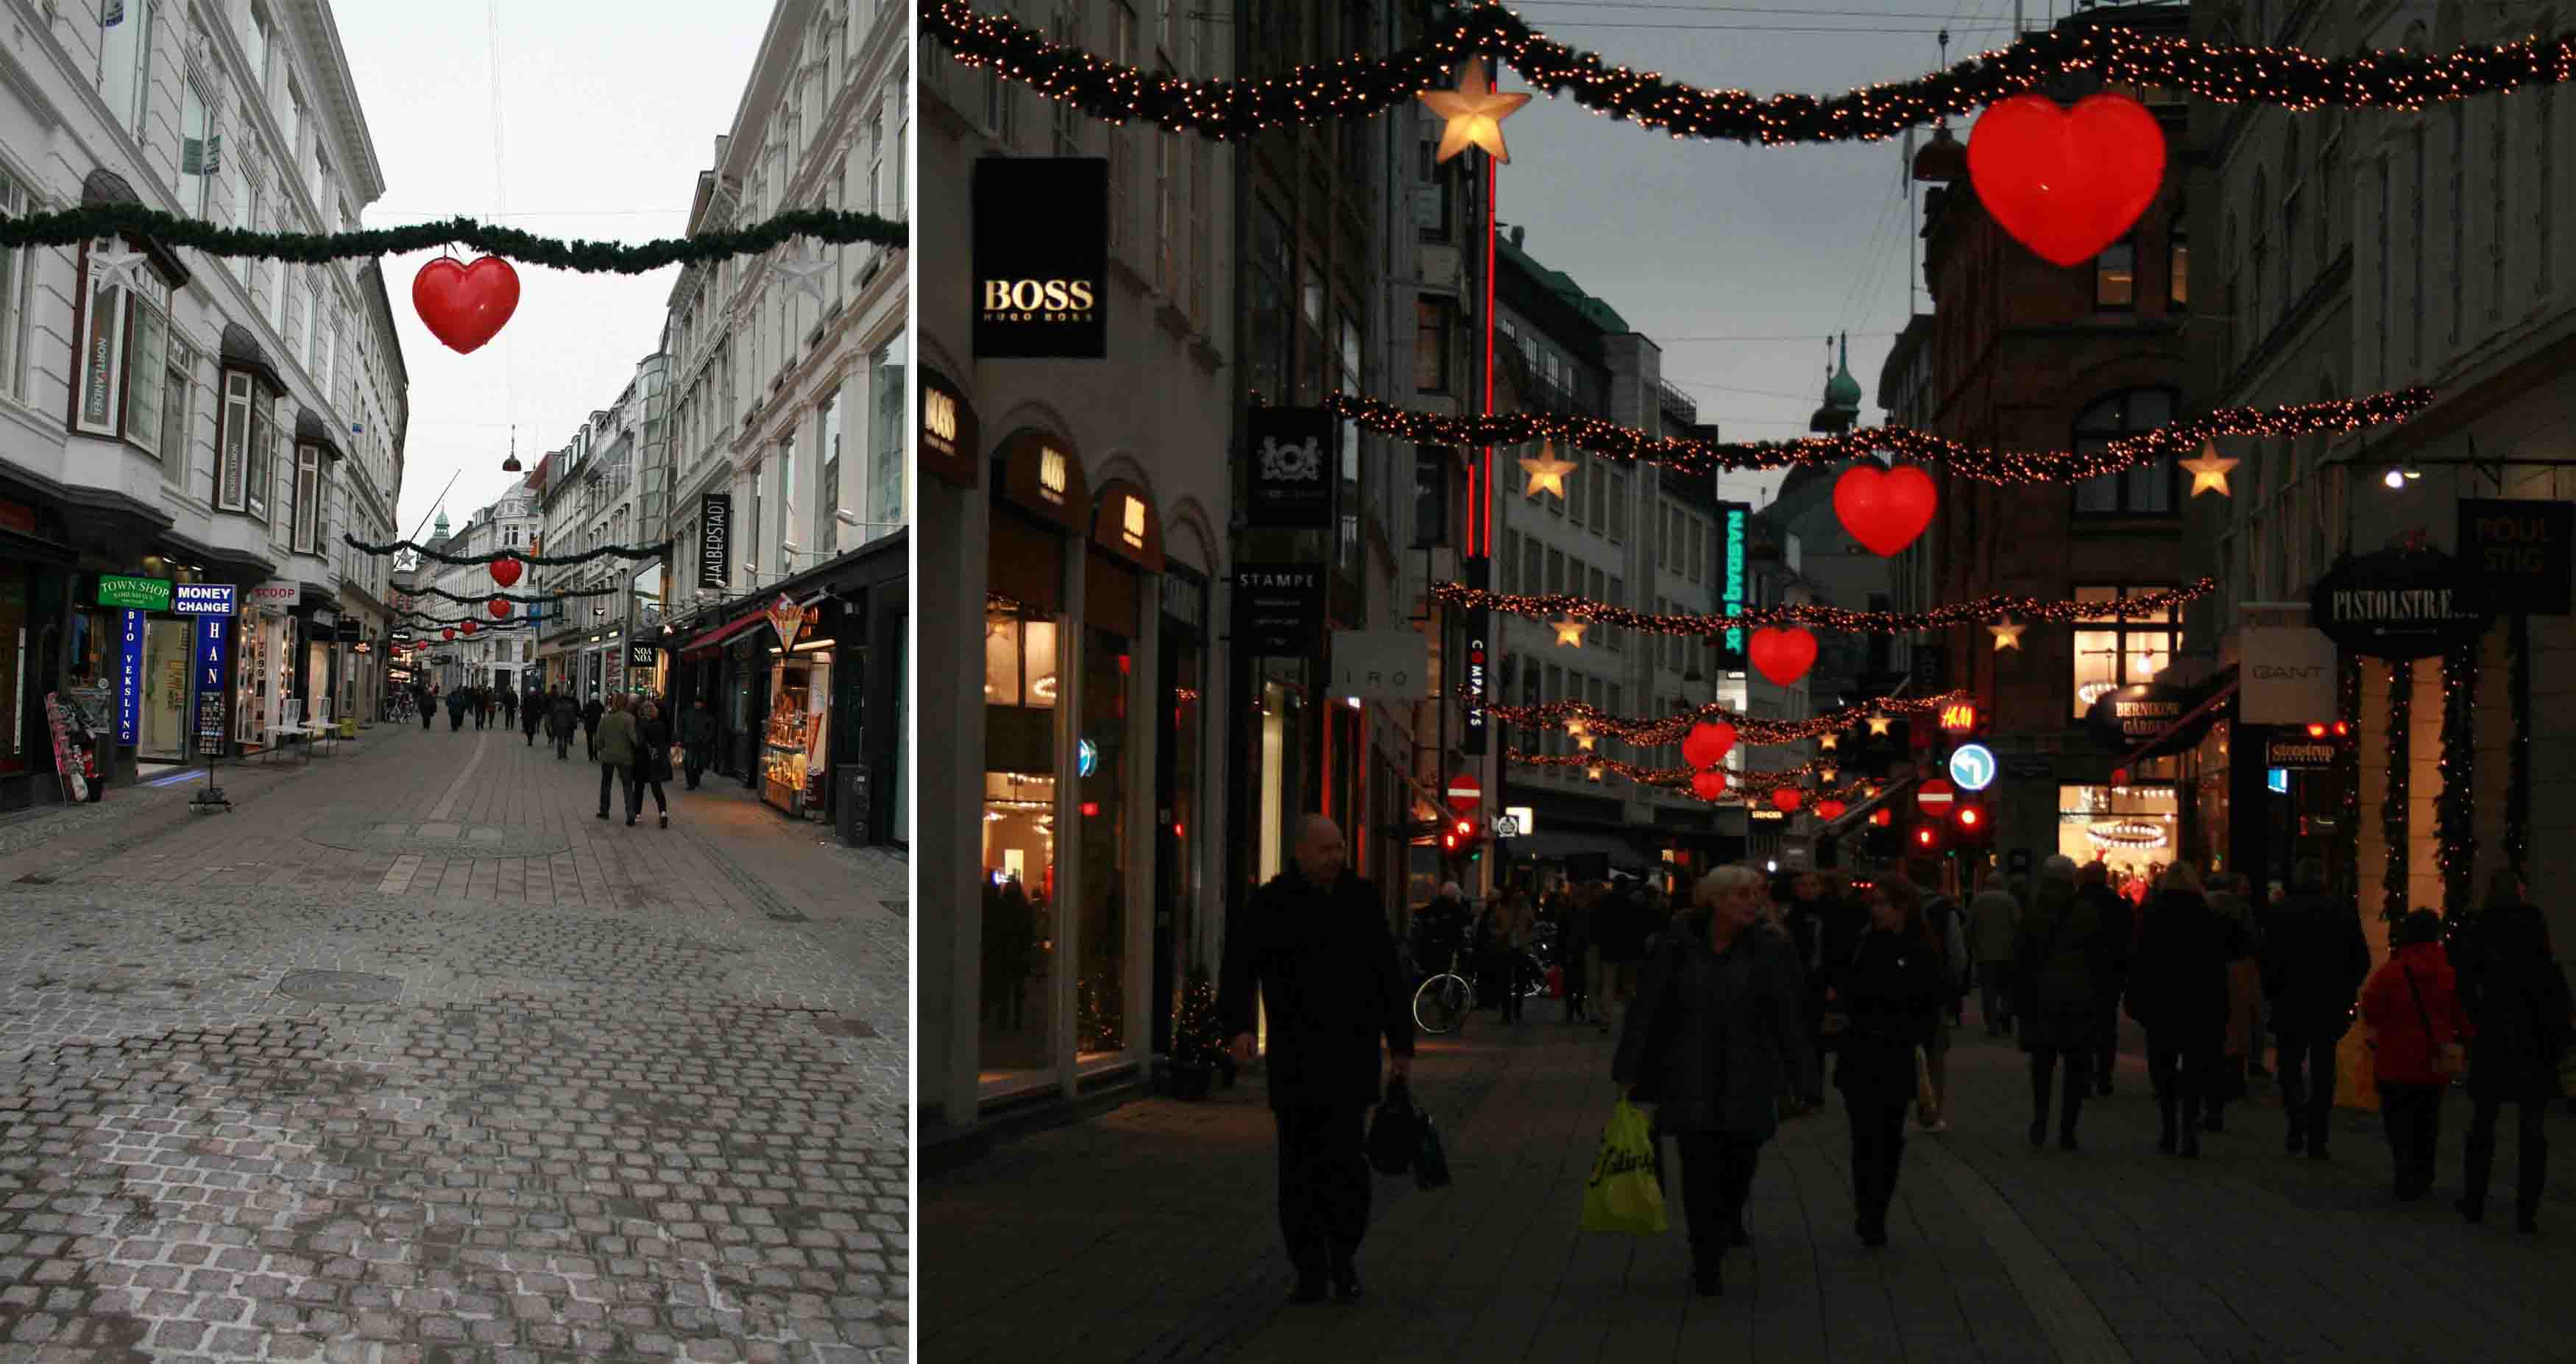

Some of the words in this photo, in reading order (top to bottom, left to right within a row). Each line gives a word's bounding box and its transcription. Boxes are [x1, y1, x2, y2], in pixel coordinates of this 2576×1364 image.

[984, 279, 1094, 311] BOSS
[705, 500, 724, 582] HALBERSTADT
[100, 580, 137, 593] TOWN
[140, 582, 169, 597] SHOP
[177, 587, 231, 599] MONEY
[177, 601, 230, 612] CHANGE
[634, 654, 653, 662] NOA
[2251, 665, 2326, 679] GANT
[1470, 639, 1484, 727] COMPAYS
[122, 654, 133, 740] VEKSLING
